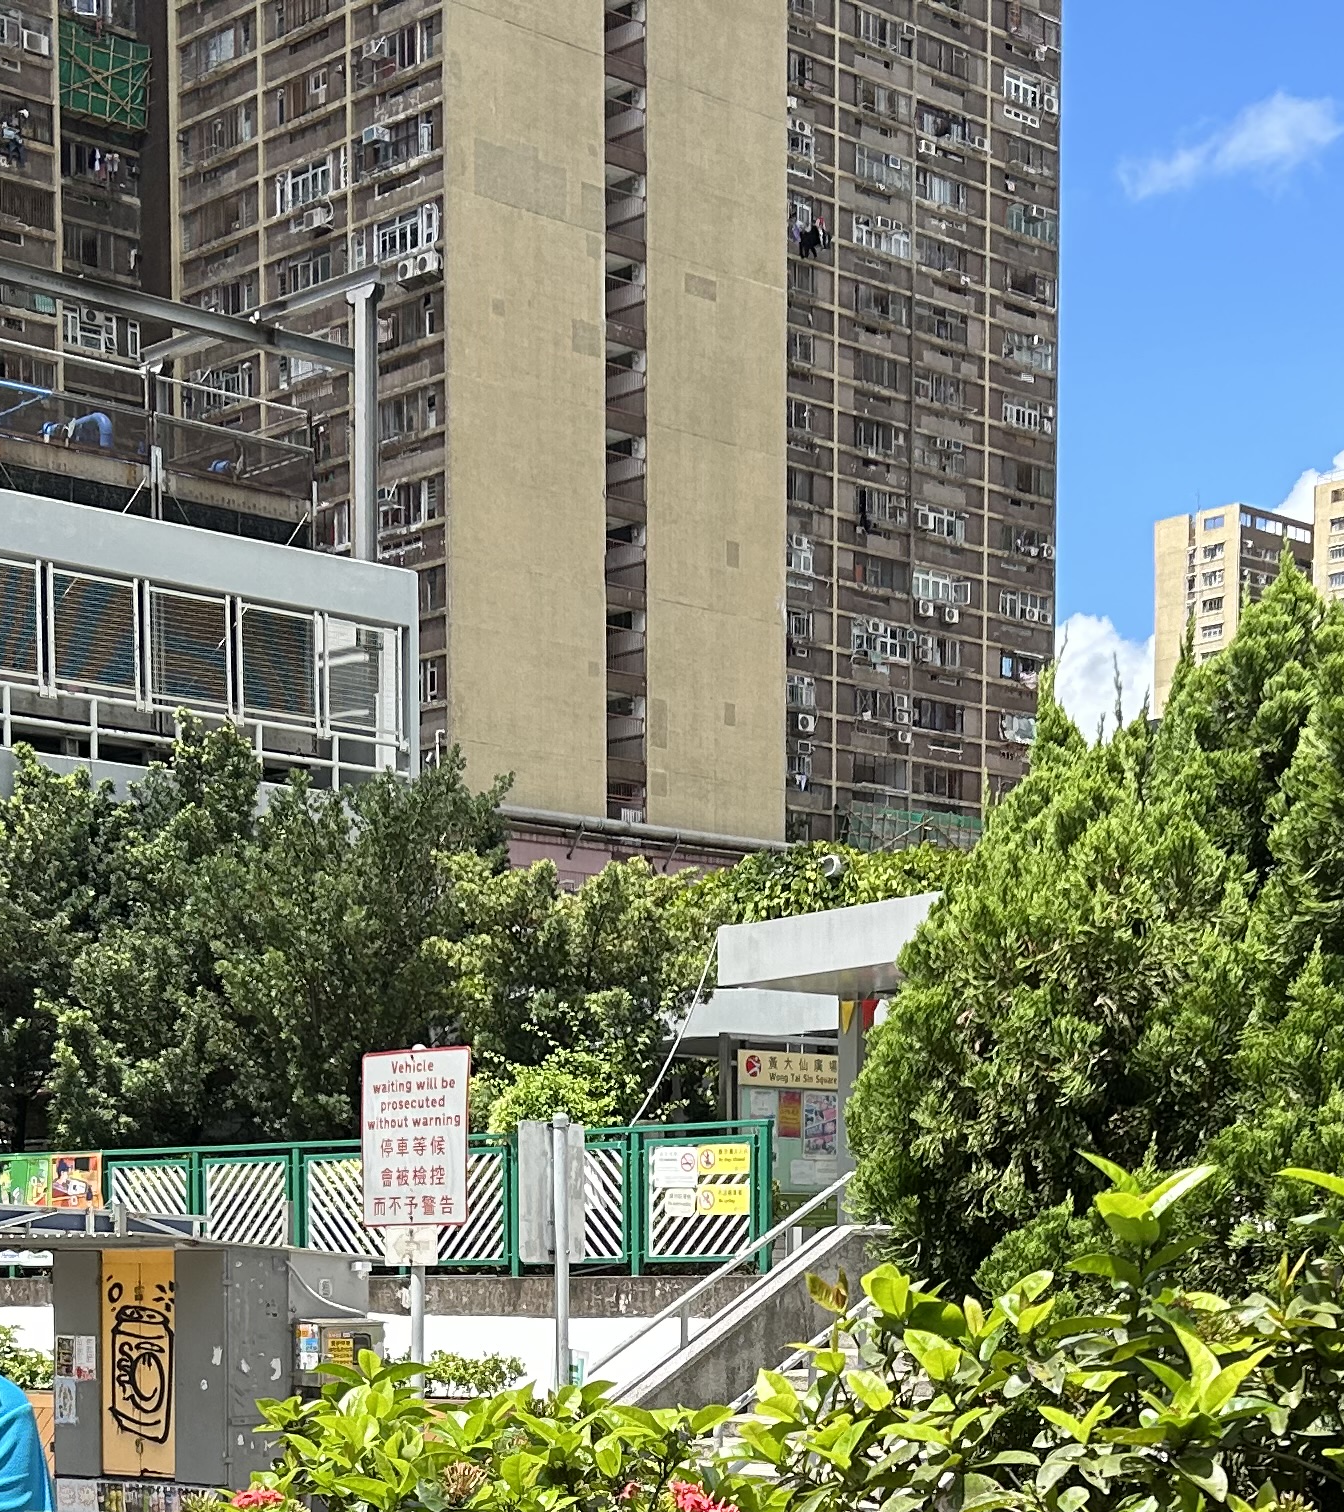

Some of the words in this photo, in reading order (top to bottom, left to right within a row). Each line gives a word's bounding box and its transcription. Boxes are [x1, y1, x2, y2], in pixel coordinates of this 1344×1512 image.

[391, 1060, 434, 1074] Vehicle
[373, 1080, 412, 1094] waiting
[416, 1077, 438, 1091] will
[441, 1076, 456, 1089] be
[769, 1072, 788, 1084] Wong
[791, 1073, 801, 1083] Tai
[803, 1073, 814, 1084] Sin
[816, 1074, 838, 1086] Square
[380, 1095, 446, 1114] prosecuted
[367, 1115, 409, 1131] without
[412, 1114, 461, 1128] warning
[380, 1135, 447, 1159] 停車等候
[380, 1165, 446, 1188] 會被檢控
[373, 1195, 455, 1217] 而不予警告
